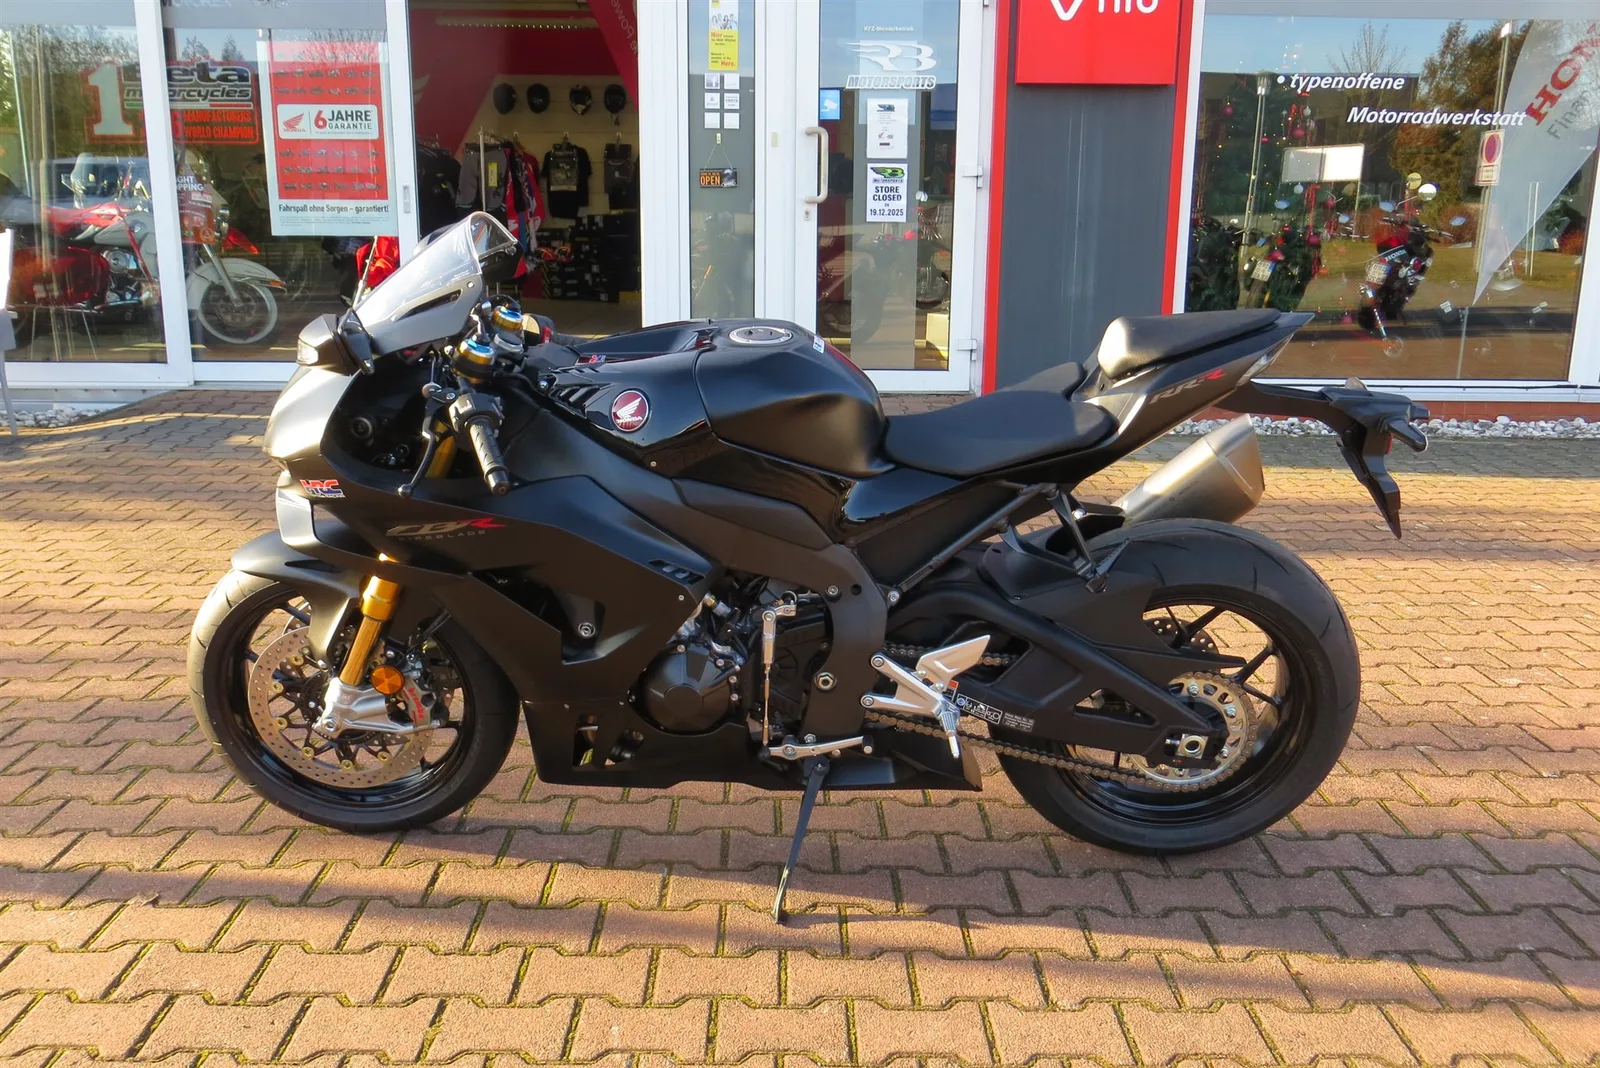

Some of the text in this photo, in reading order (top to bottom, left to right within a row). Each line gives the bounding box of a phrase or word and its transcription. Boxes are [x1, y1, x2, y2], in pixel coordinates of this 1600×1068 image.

[846, 75, 936, 89] MOTORSPORTS
[1290, 72, 1405, 93] typenoffene
[314, 110, 372, 130] 6 JAHRE
[1346, 107, 1527, 126] Motorradwerkstatt
[184, 126, 254, 139] WORLD CHAMPION
[700, 175, 721, 185] OPEN
[279, 203, 308, 214] Fahrspaß
[309, 204, 325, 212] ohne
[326, 204, 349, 214] Sorgen
[355, 205, 389, 214] garantiert!
[870, 208, 904, 216] 19.12.2025
[615, 416, 643, 424] HONDA
[300, 479, 344, 495] HRC
